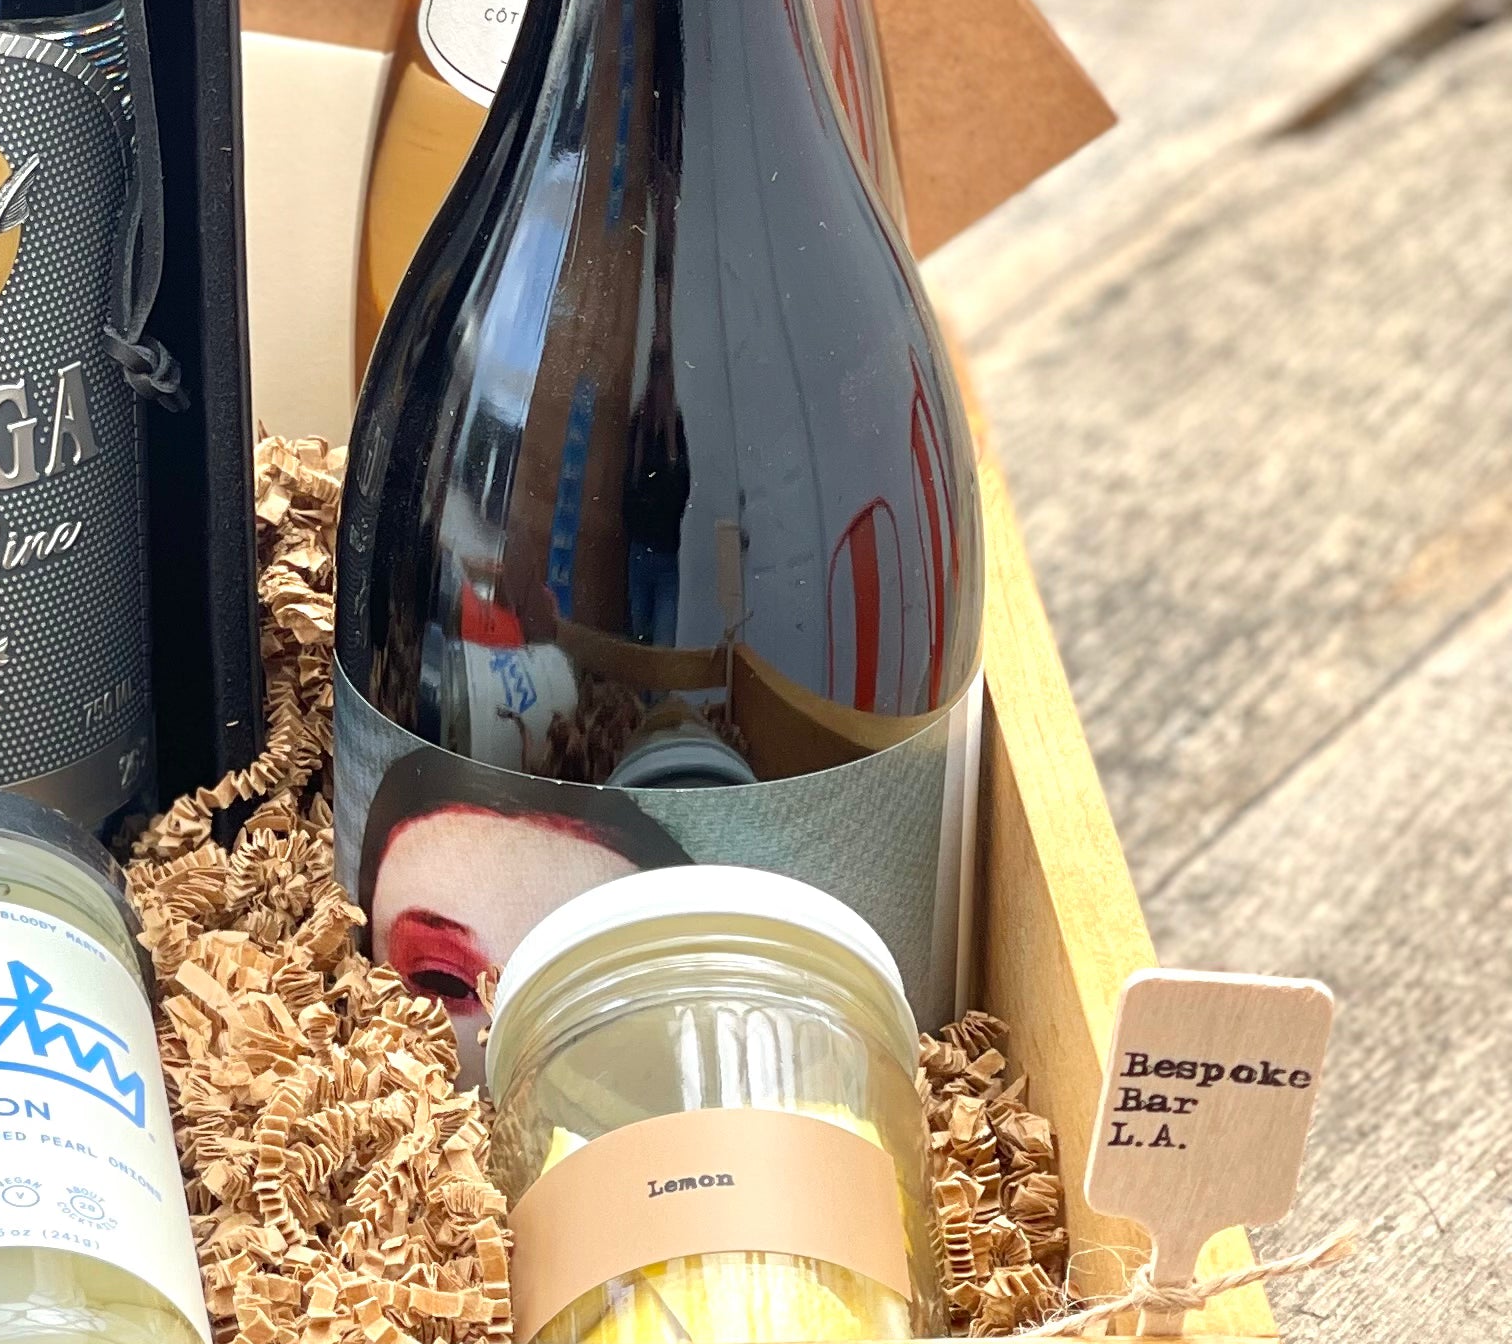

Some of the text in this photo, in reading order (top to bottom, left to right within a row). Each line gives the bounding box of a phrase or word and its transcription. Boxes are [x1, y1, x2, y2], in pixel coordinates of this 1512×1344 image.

[0, 910, 57, 933] BLOODY
[65, 931, 107, 963] MARYS
[1119, 1052, 1313, 1089] Bespoke
[1113, 1087, 1199, 1115] Bar
[1107, 1121, 1187, 1149] L.A.
[40, 1133, 99, 1159] PEARL
[108, 1156, 163, 1203] ONIONS
[66, 1186, 106, 1204] ABOUT
[647, 1170, 735, 1198] Lemon
[56, 1201, 119, 1231] COCKTAILS
